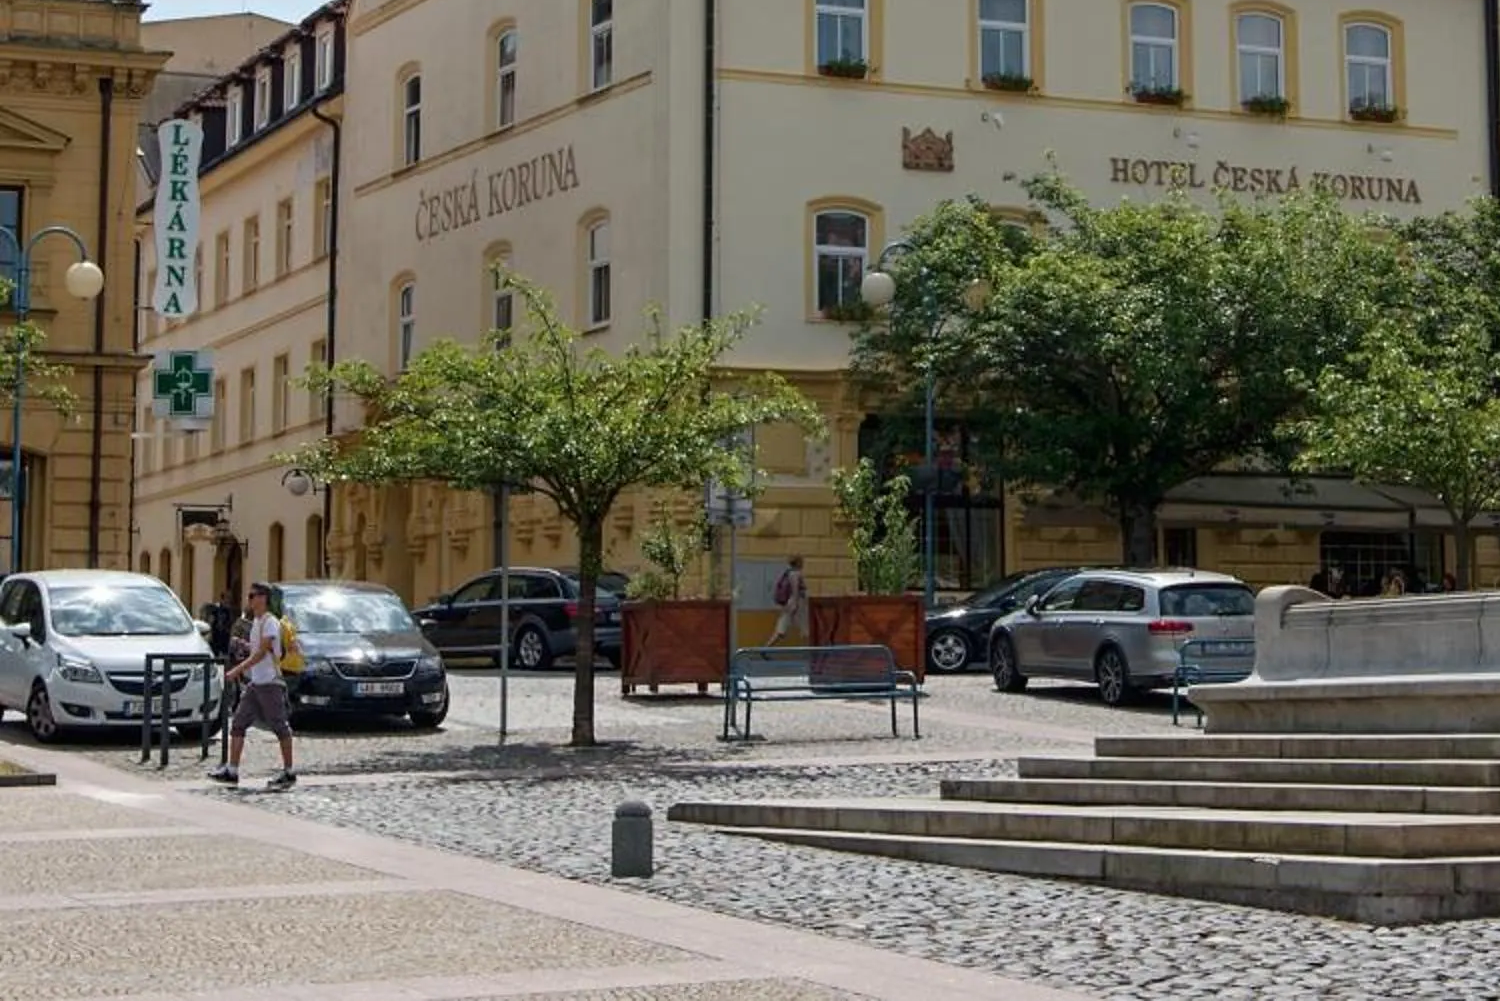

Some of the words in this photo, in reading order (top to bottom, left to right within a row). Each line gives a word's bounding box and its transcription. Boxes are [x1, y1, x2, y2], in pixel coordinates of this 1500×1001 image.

[163, 124, 190, 314] LÉKÁRNA
[415, 168, 481, 241] ČESKÁ
[487, 143, 580, 217] KORUNA
[1109, 157, 1205, 189] HOTEL
[1213, 160, 1300, 194] ČESKÁ
[1311, 171, 1422, 204] KORUNA
